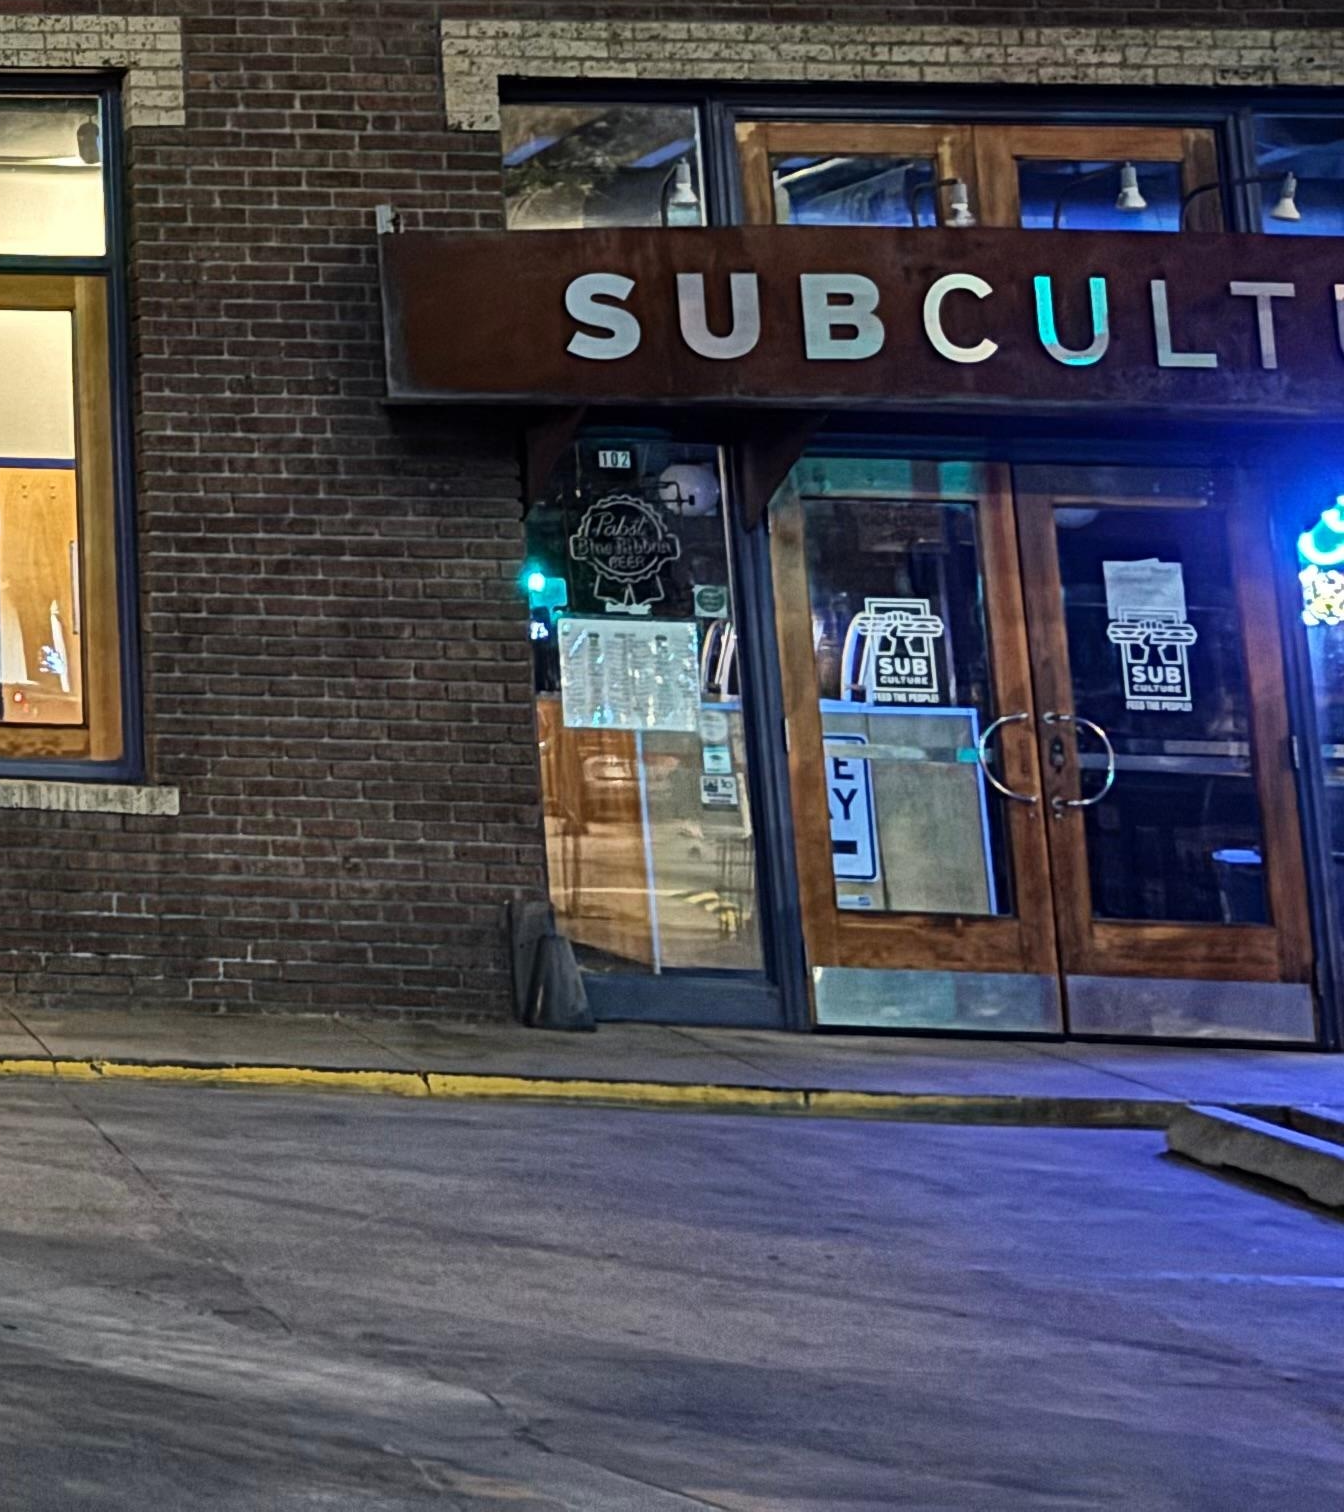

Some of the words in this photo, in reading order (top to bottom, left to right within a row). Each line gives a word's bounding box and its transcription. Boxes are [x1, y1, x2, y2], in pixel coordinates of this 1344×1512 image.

[564, 272, 1344, 370] SUBCULT
[601, 451, 629, 467] 102
[591, 511, 648, 537] Pabst
[878, 656, 929, 676] SUB
[1131, 666, 1182, 684] SUB
[879, 676, 929, 685] CULTURE
[1132, 684, 1183, 694] CULTURE
[830, 787, 859, 821] Y
